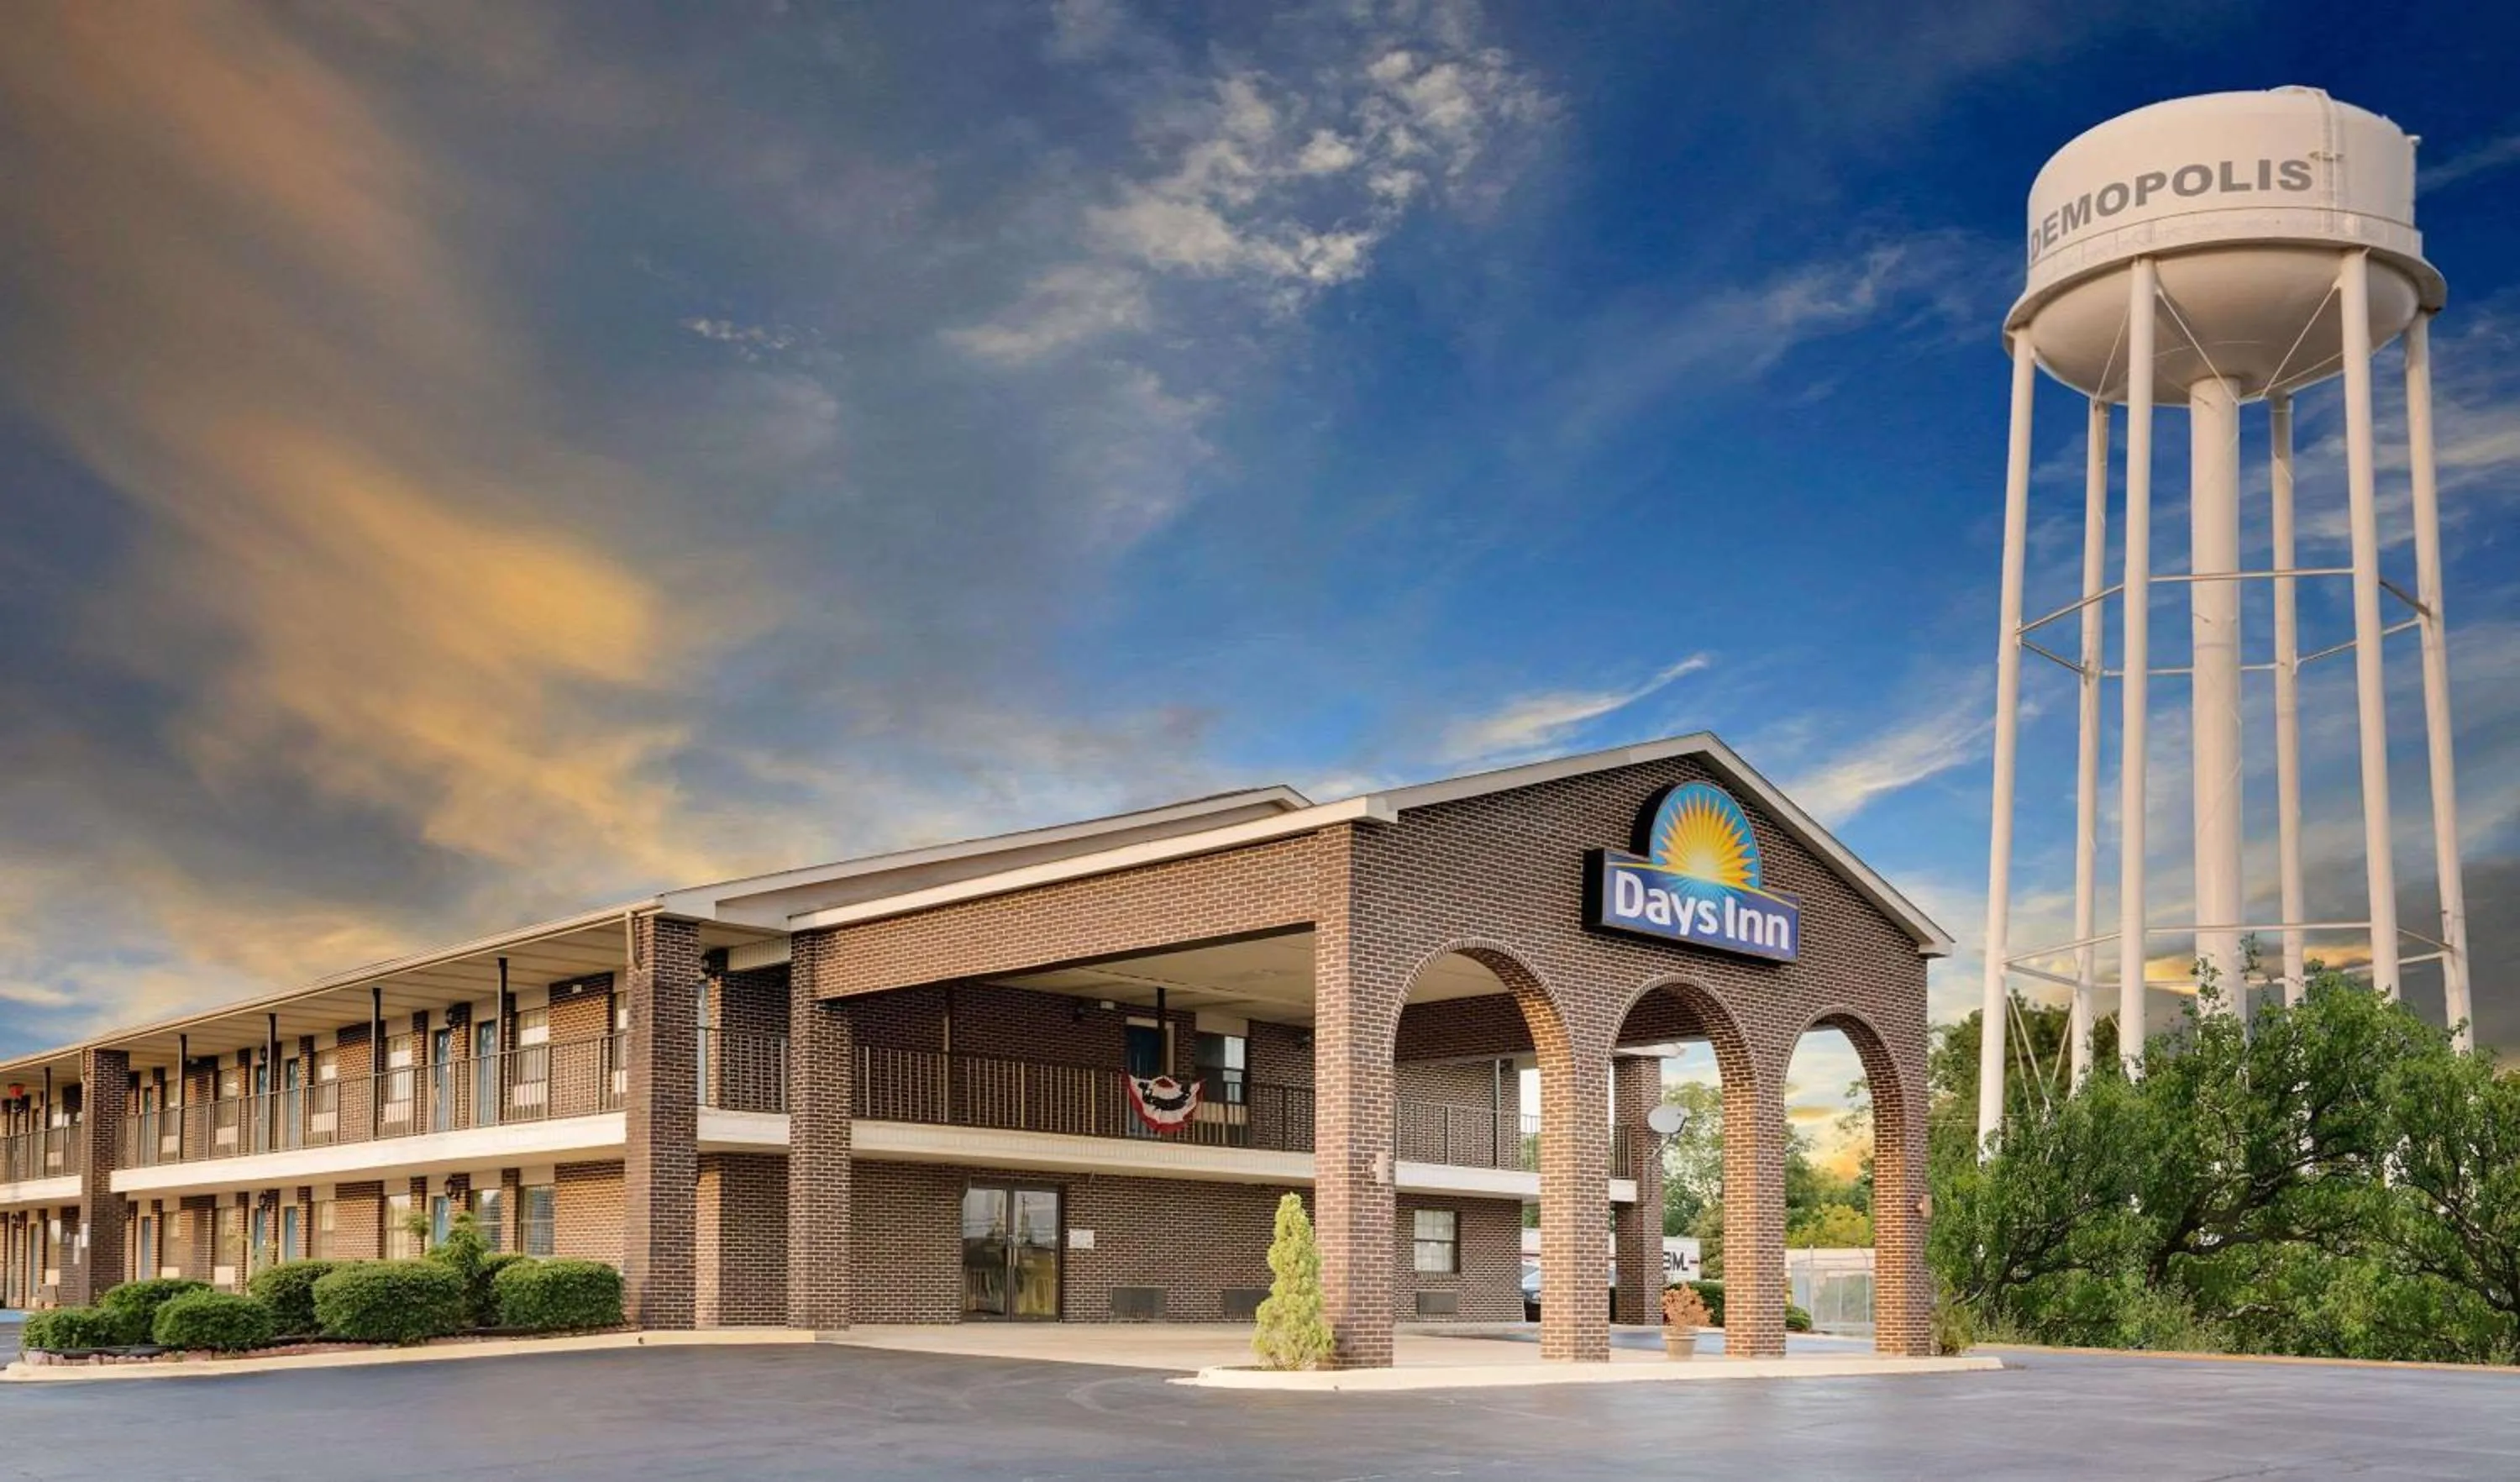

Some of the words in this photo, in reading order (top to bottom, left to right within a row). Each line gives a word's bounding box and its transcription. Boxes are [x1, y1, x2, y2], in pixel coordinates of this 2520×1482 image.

[2031, 159, 2313, 261] DEMOPOLIS
[1615, 870, 1719, 936] Days
[1725, 896, 1789, 950] Inn
